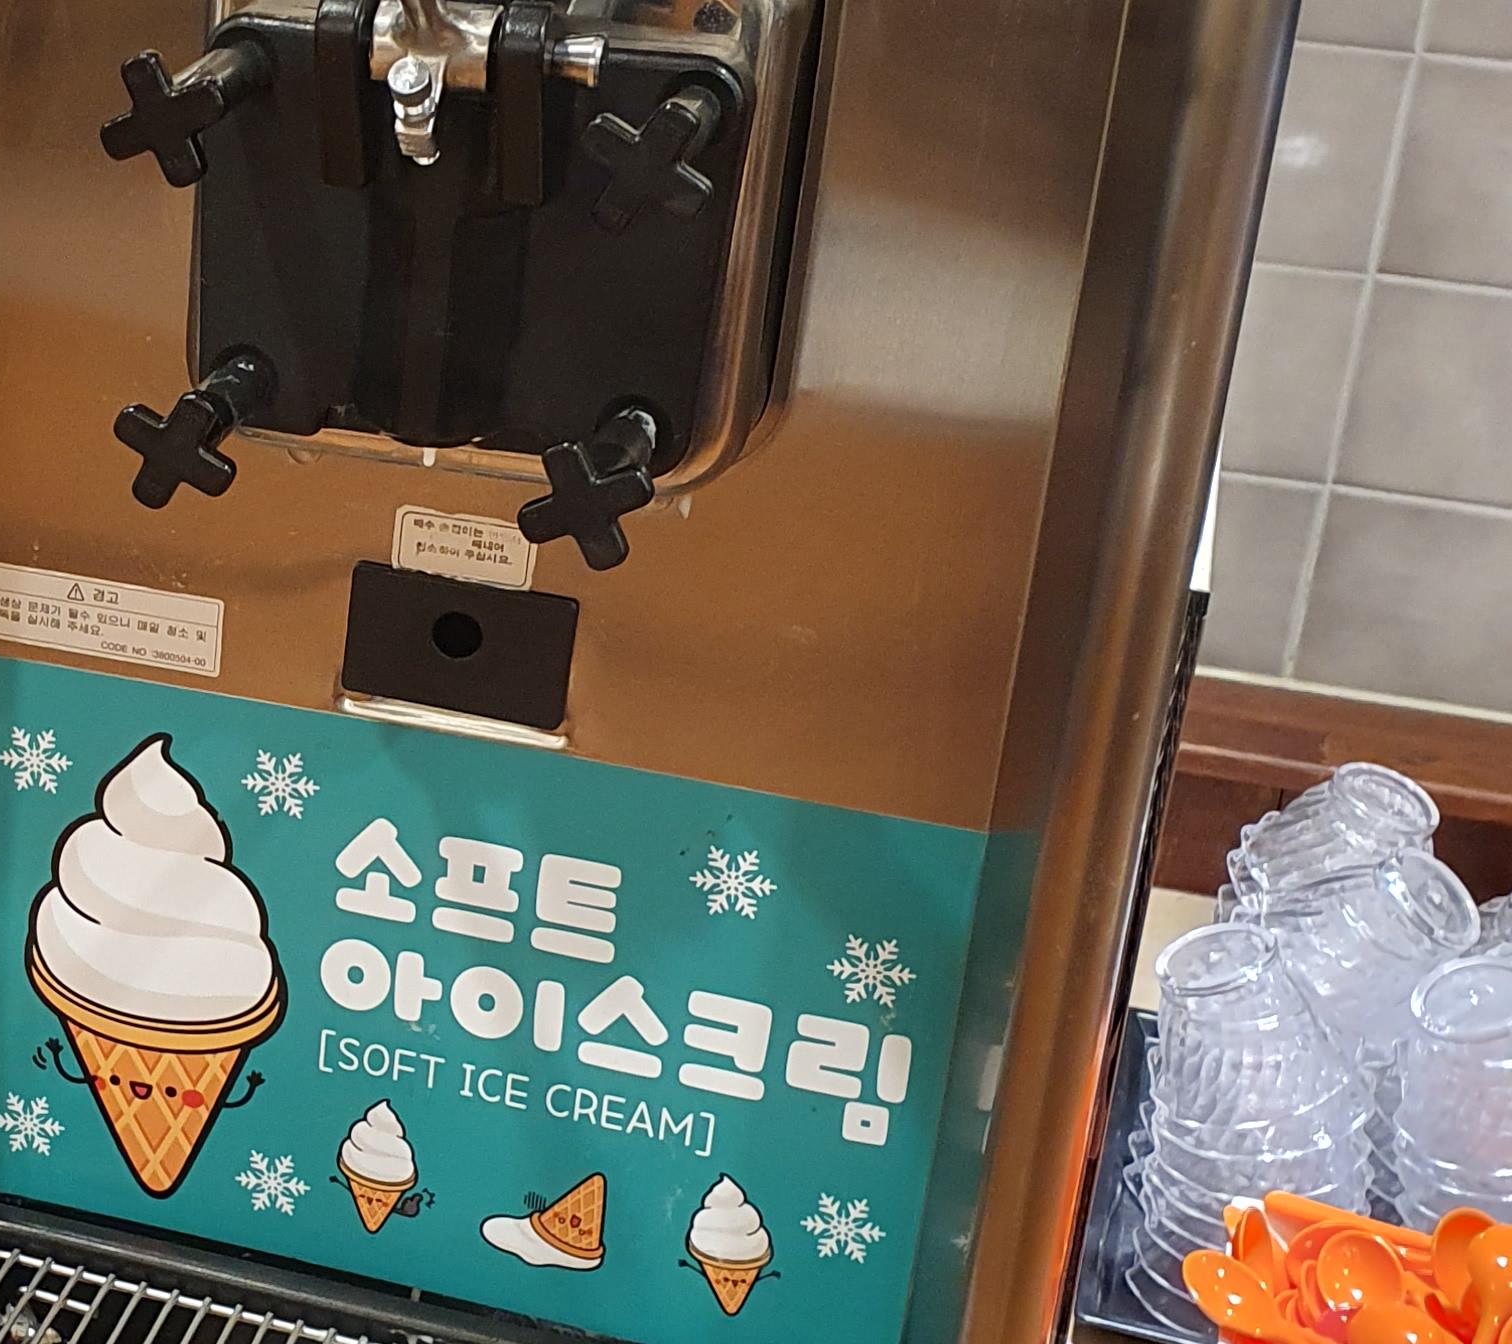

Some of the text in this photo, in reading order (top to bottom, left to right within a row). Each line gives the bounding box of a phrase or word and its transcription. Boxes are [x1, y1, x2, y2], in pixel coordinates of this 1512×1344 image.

[93, 587, 120, 604] 경고
[100, 640, 128, 654] CODE
[132, 646, 147, 657] NO
[334, 817, 623, 964] 소프트
[319, 938, 912, 1147] 아이스크림
[460, 1063, 531, 1109] ICE
